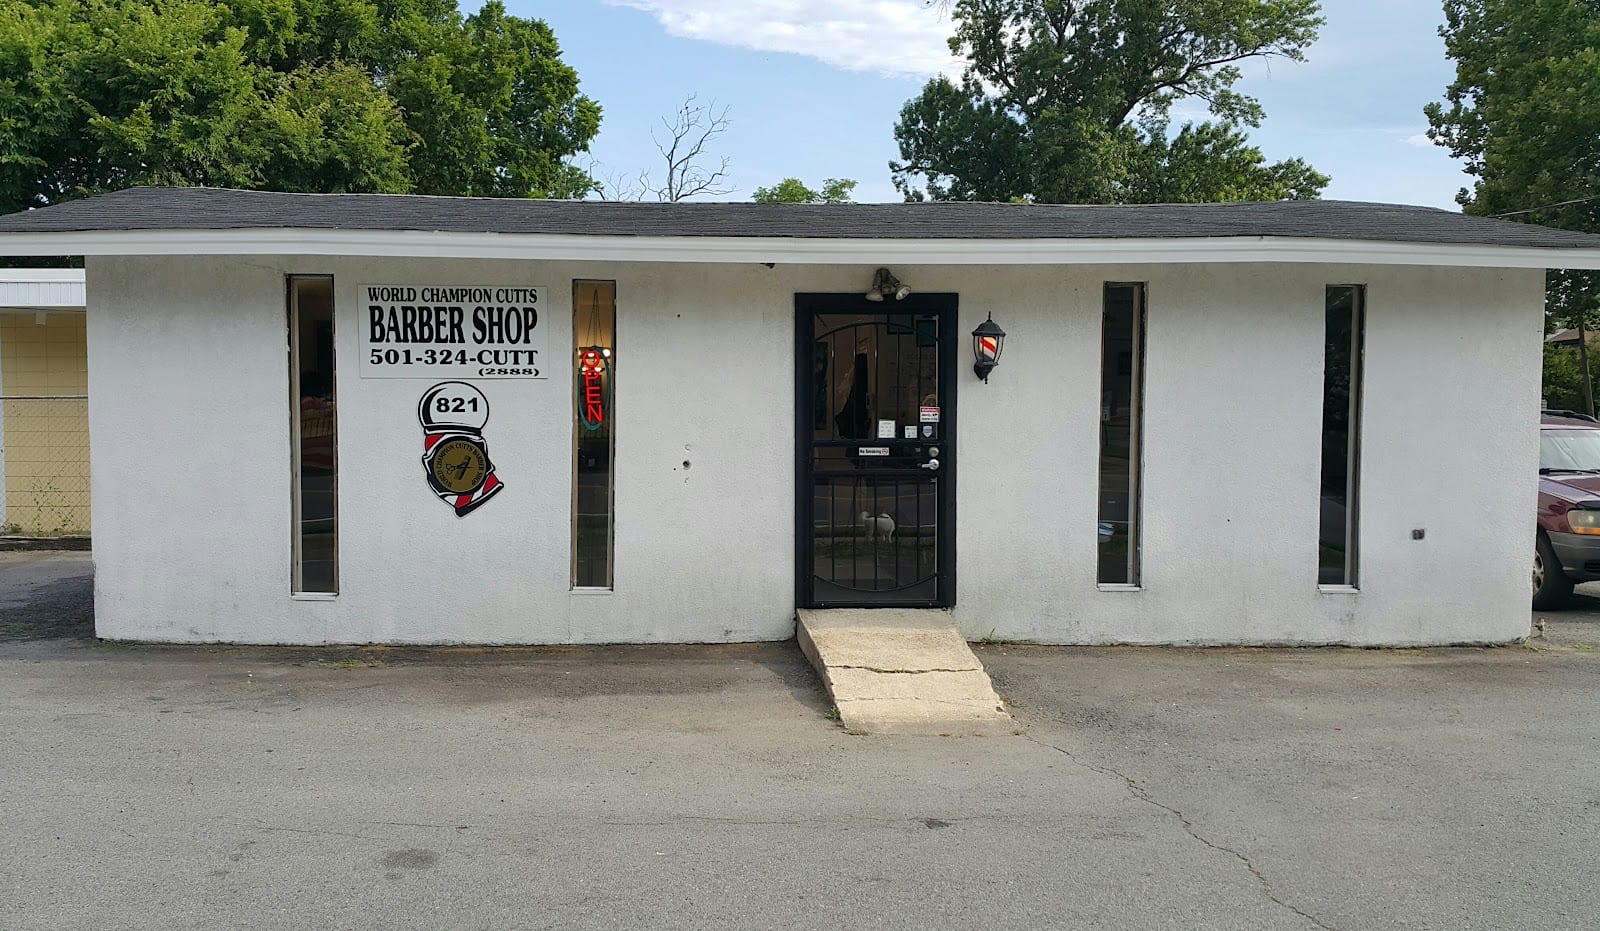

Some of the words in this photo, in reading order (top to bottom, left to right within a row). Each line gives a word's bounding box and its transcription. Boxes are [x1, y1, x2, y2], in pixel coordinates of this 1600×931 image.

[367, 286, 417, 302] WORLD
[421, 287, 493, 303] CHAMPION
[495, 288, 538, 303] CUTTS
[369, 306, 466, 344] BARBER
[472, 306, 538, 345] SHOP
[370, 349, 539, 366] 501-324-CUTT
[478, 368, 540, 377] (2888)
[582, 350, 603, 421] OPEN
[436, 397, 478, 413] 821
[455, 442, 472, 451] CUTTS
